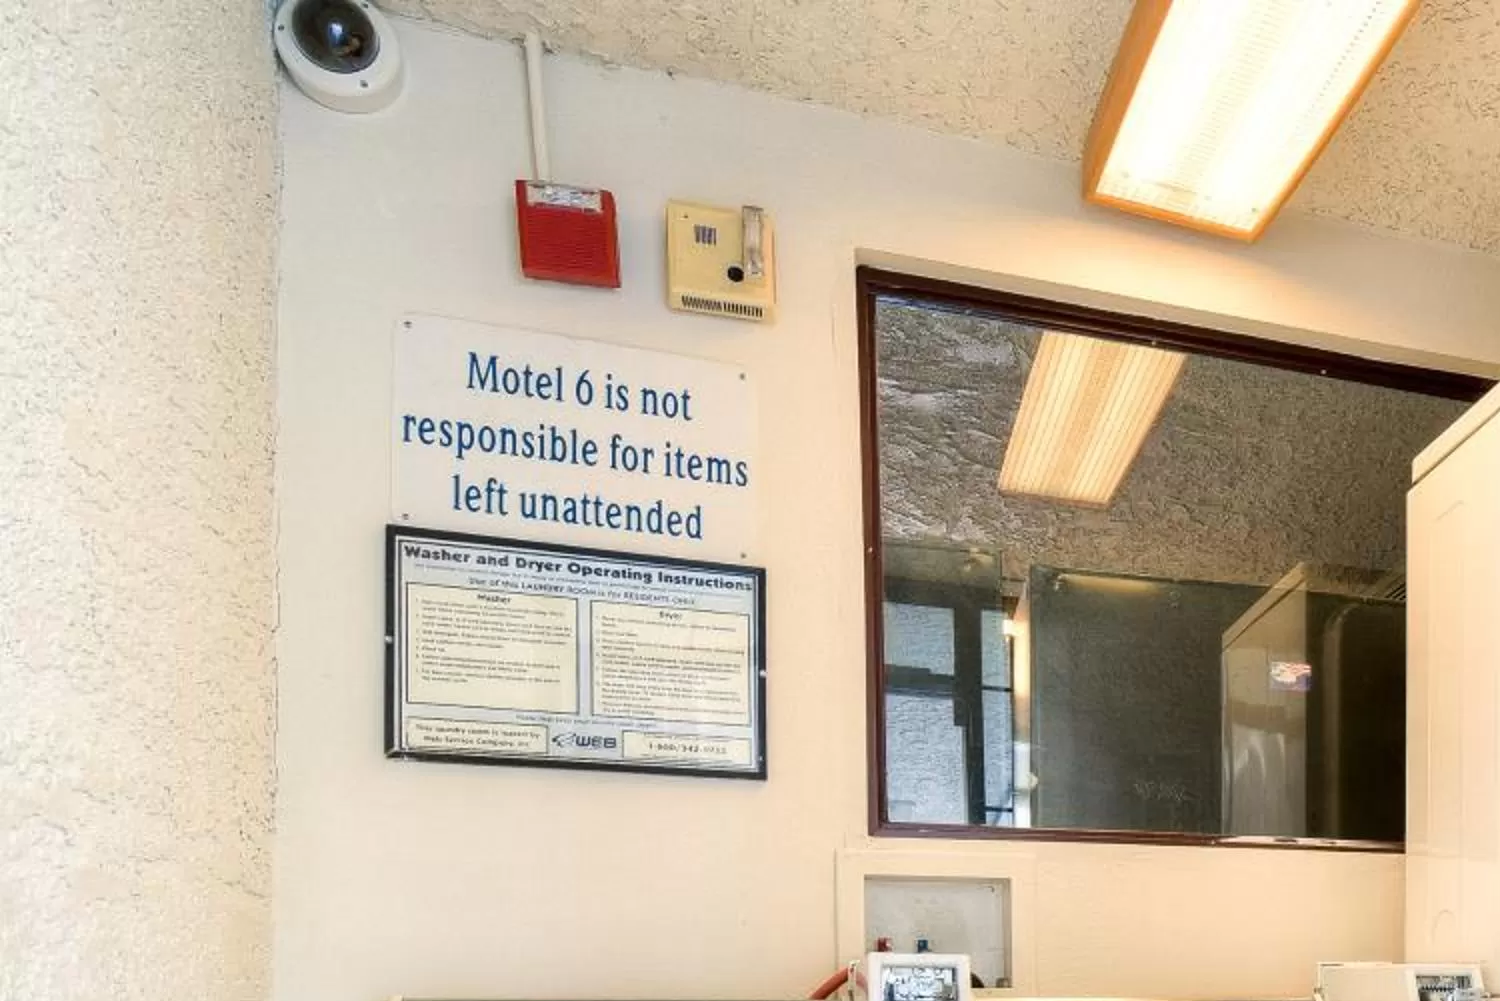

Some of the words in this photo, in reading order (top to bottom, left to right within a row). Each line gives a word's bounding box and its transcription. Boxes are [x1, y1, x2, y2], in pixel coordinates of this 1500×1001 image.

[467, 352, 565, 401] Motel
[575, 370, 594, 405] 6
[605, 374, 629, 411] is
[640, 387, 692, 421] not
[402, 414, 598, 467] responsible
[610, 434, 655, 474] for
[664, 442, 748, 487] items
[452, 475, 508, 515] left
[519, 491, 702, 540] unattended
[404, 545, 471, 563] Washer
[476, 555, 509, 567] and
[516, 557, 563, 573] Dryer
[567, 562, 653, 584] Operating
[658, 571, 752, 591] Instructions
